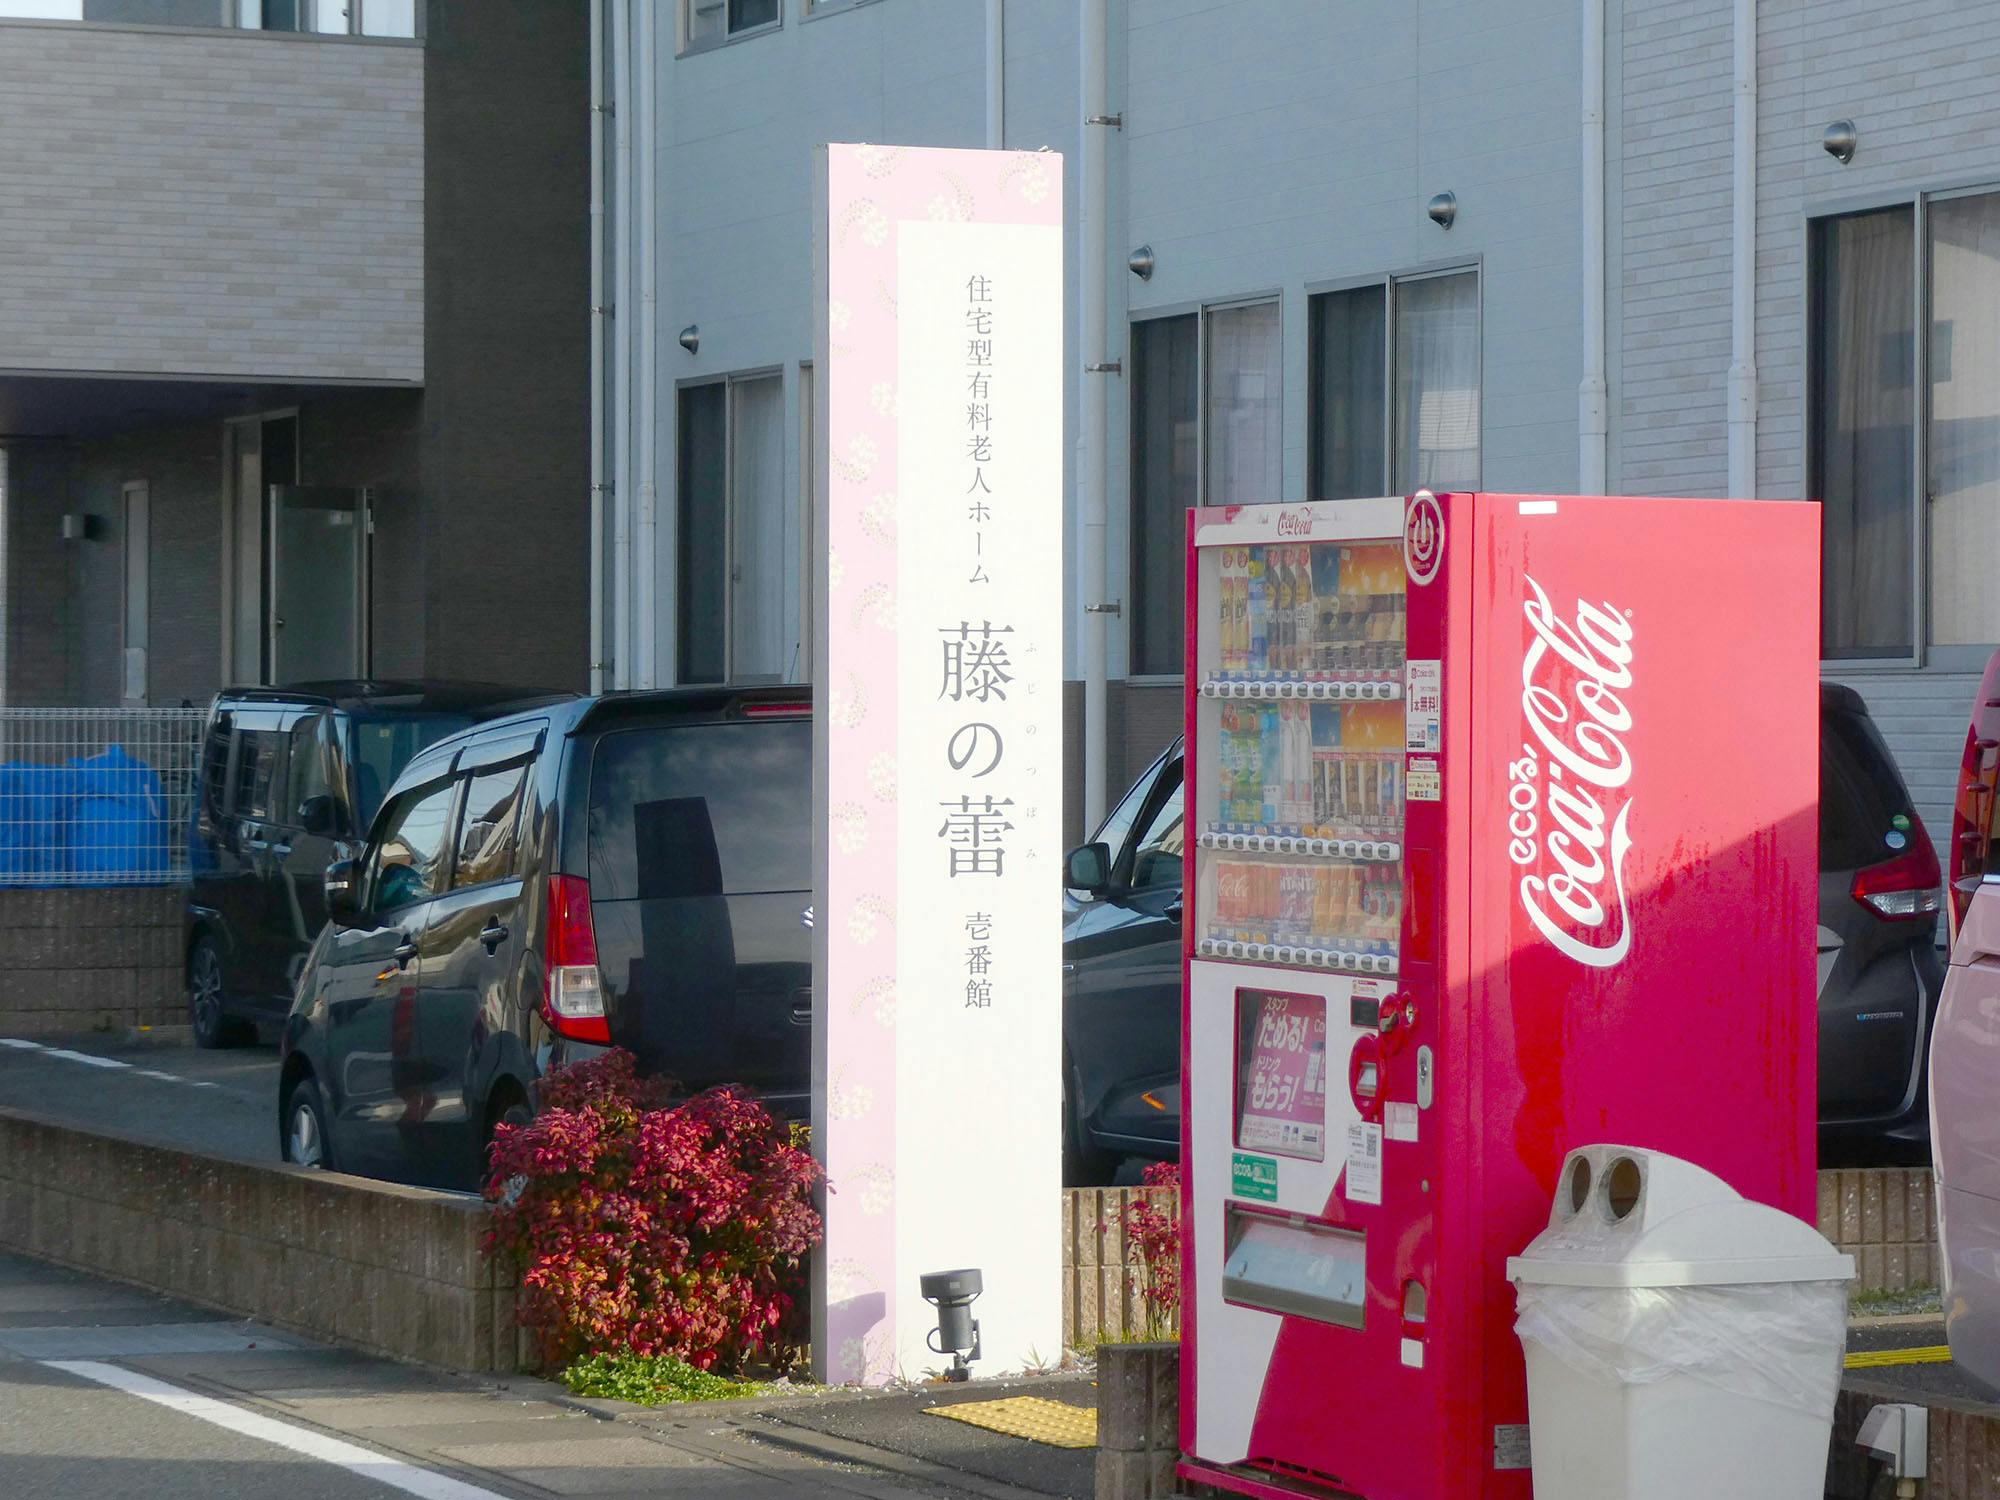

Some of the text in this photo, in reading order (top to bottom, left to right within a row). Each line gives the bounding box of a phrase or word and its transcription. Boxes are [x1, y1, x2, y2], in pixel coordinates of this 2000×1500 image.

[966, 274, 993, 584] 住宅型有料老人ホーム
[937, 619, 1016, 879] 藤の蕾
[1025, 642, 1038, 859] ふじのつぼみ
[1521, 573, 1633, 967] Coca-Cola
[964, 911, 993, 1009] 壱番館
